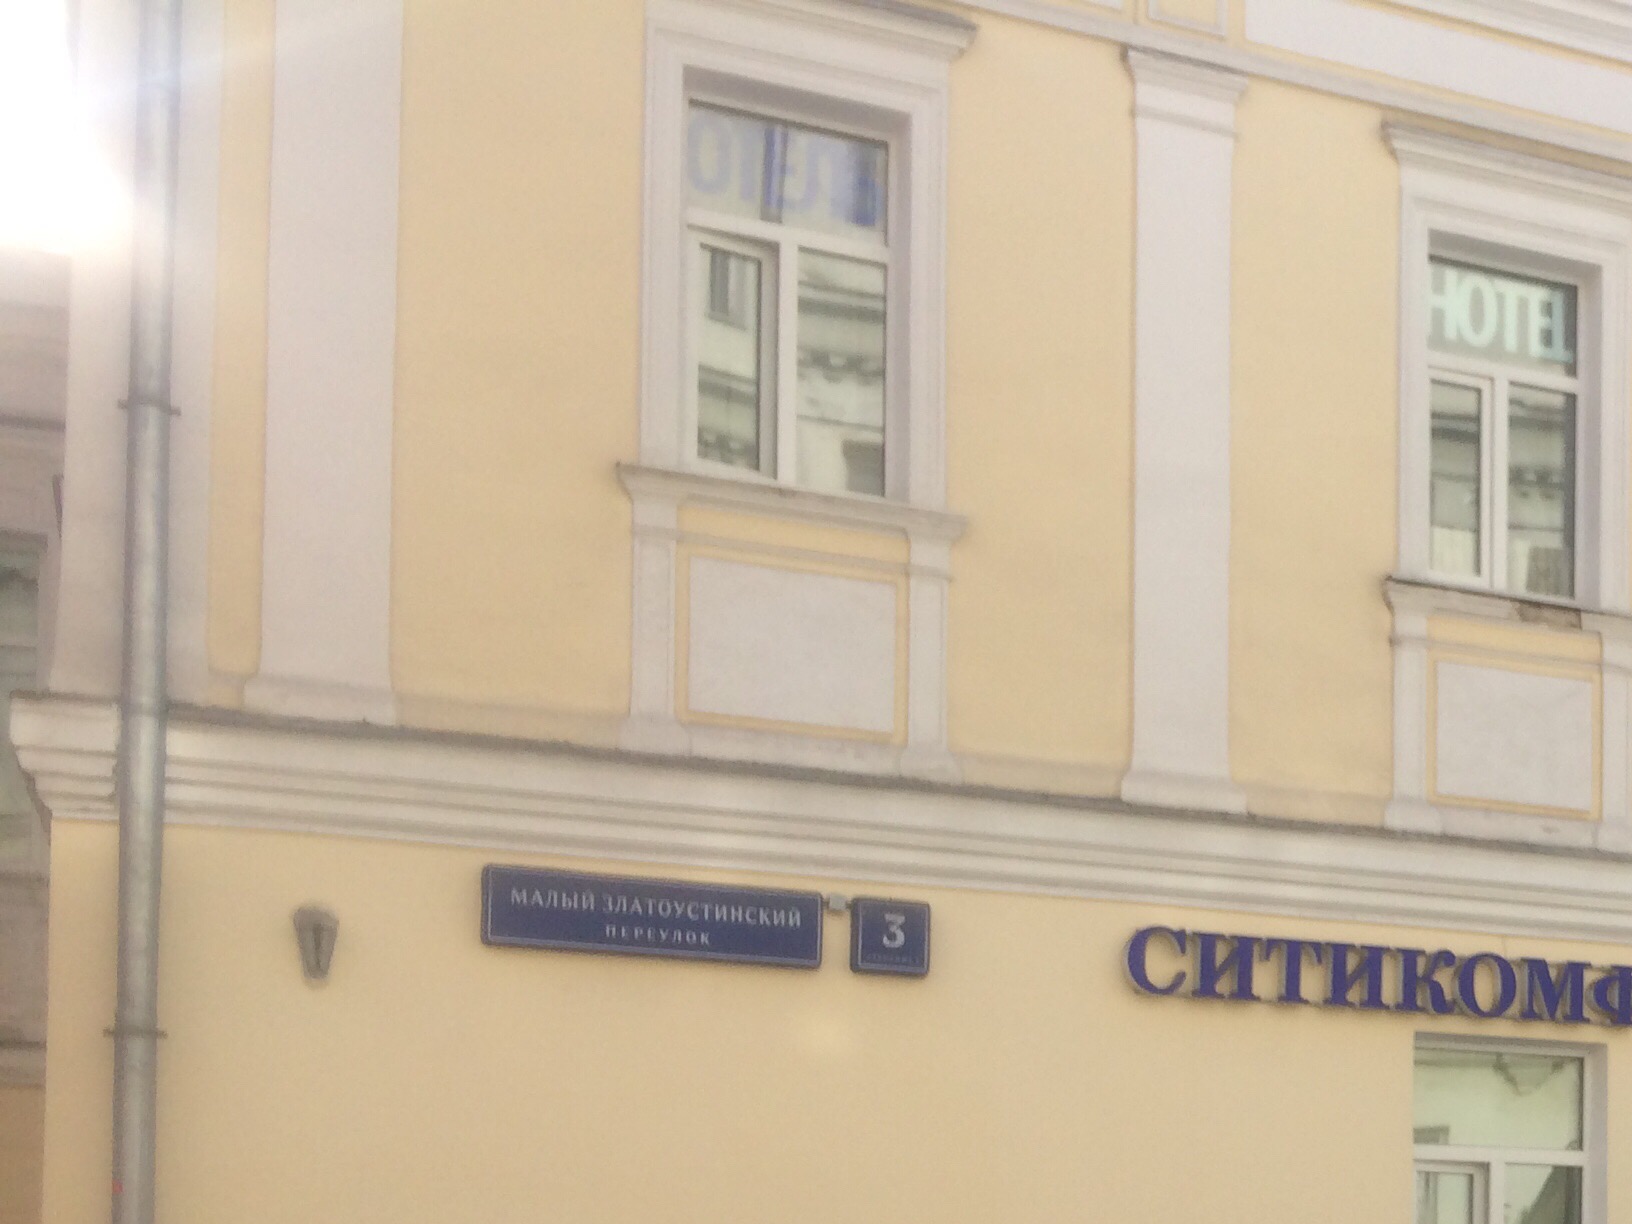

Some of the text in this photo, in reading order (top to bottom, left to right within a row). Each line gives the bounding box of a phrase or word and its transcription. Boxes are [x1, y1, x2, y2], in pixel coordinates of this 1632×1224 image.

[511, 886, 801, 929] МАЛЫЙ ЗЛАТОУСТИНСКИЙ
[605, 923, 710, 946] ПЕРЕУЛОК
[882, 913, 905, 949] 3
